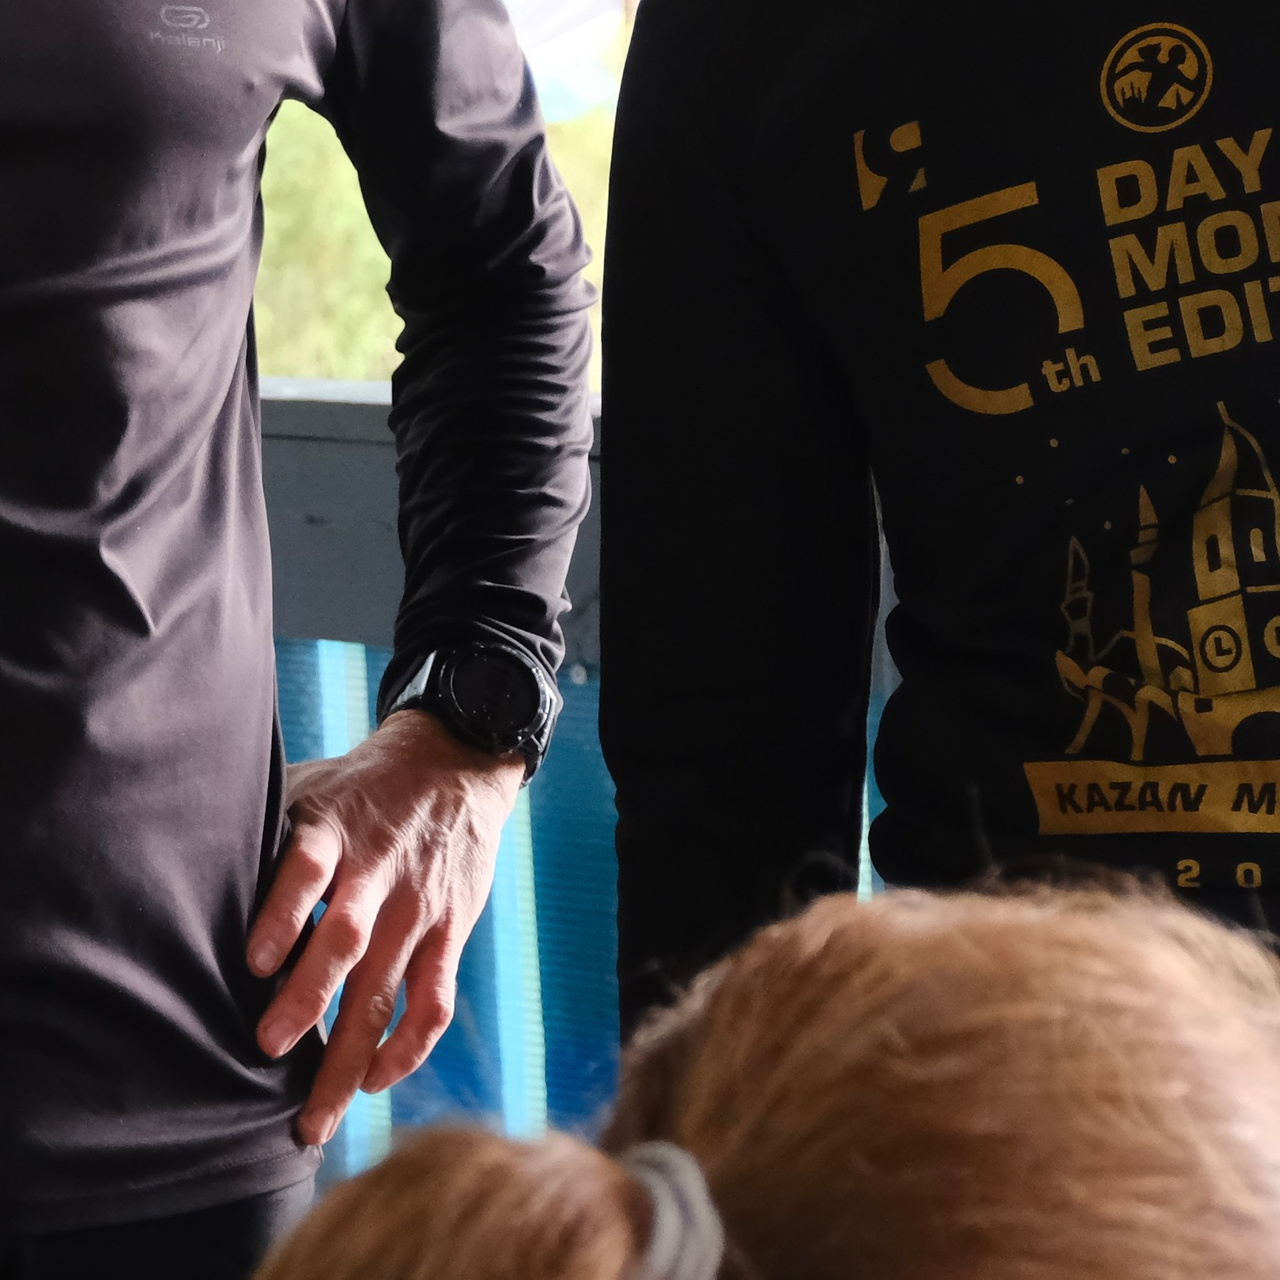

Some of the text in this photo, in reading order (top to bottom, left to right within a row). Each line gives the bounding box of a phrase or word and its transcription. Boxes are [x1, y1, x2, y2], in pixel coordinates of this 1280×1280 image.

[1096, 127, 1273, 227] DAY
[1123, 275, 1280, 372] EDI
[1054, 780, 1208, 815] KAZAN
